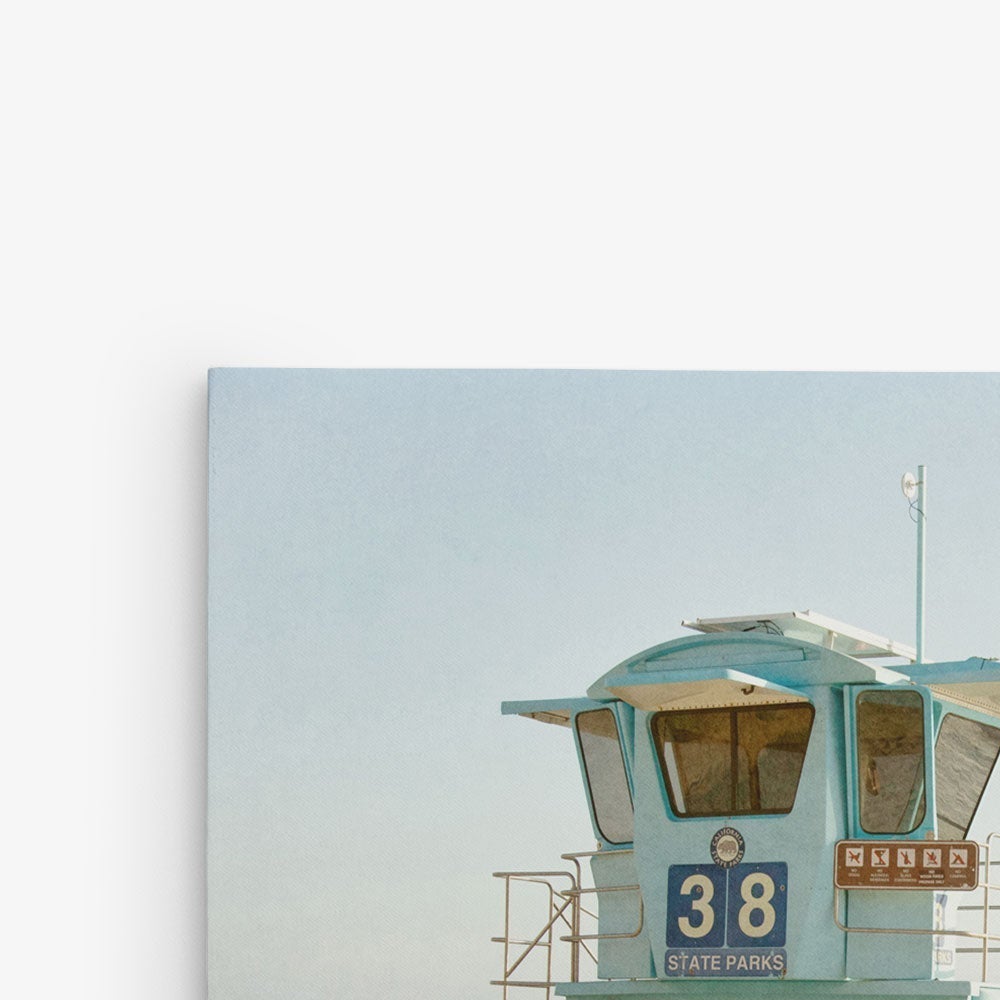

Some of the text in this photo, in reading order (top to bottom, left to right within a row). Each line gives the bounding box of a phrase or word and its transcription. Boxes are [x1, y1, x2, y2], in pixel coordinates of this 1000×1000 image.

[712, 828, 743, 846] CALIFORNIA
[712, 850, 744, 868] STATE PARKS
[668, 954, 785, 971] STATE PARKS
